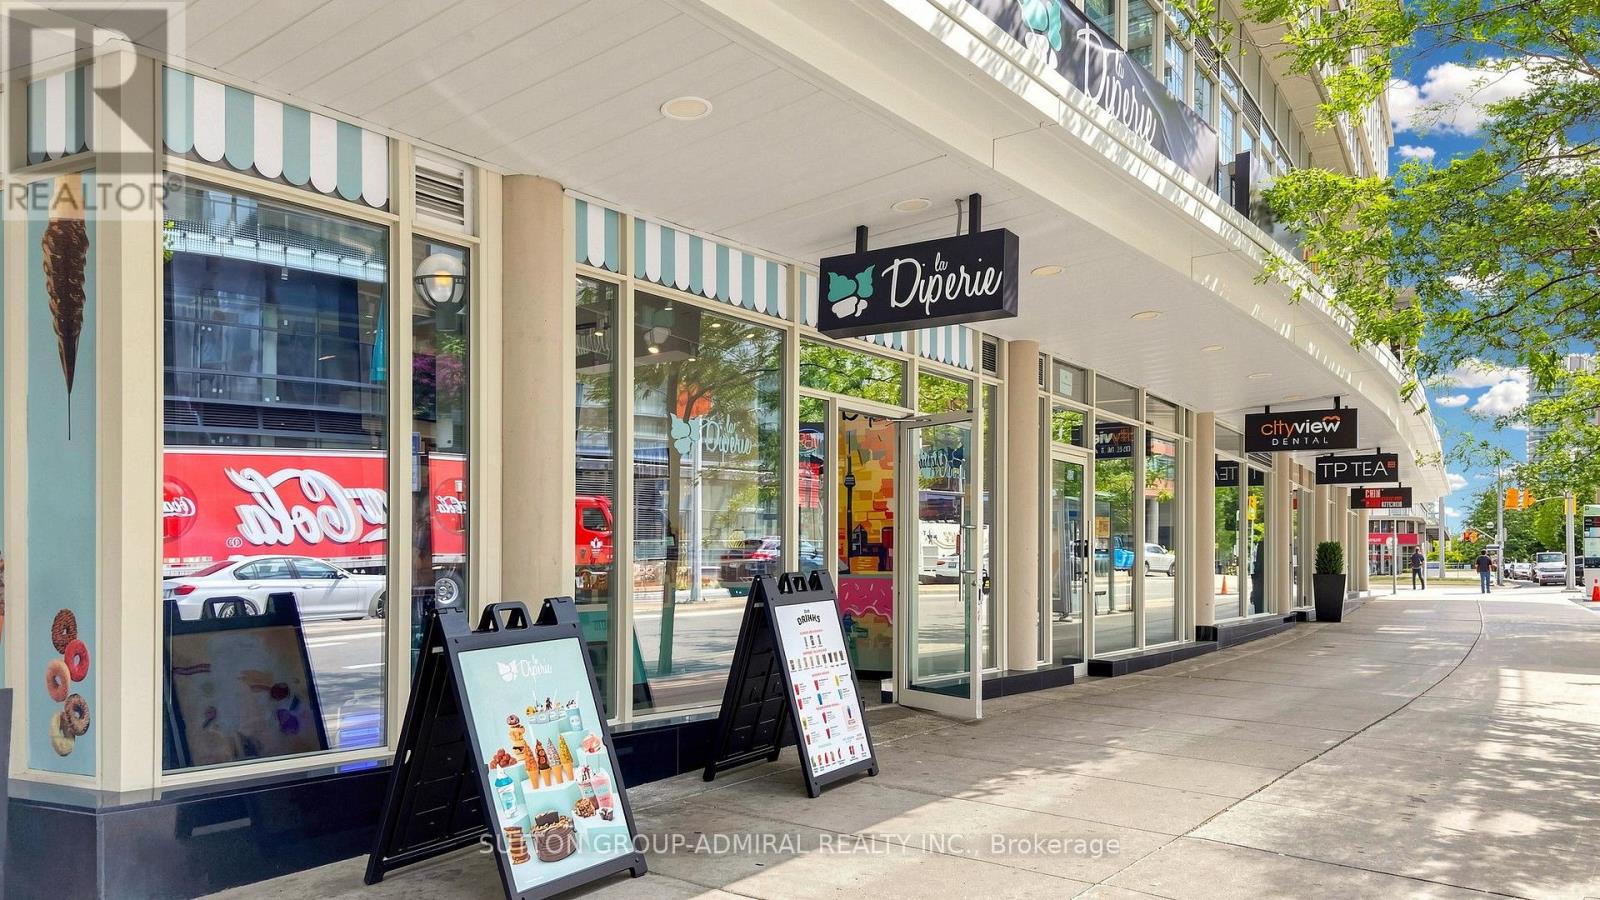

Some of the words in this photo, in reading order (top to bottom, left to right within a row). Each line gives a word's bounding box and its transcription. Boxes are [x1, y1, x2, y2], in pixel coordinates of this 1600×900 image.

[1077, 22, 1157, 146] Diperie
[934, 252, 949, 272] la
[881, 258, 1003, 315] Diperie
[1261, 417, 1340, 438] cityview
[1271, 436, 1329, 446] DENTAL
[1318, 462, 1348, 478] TP
[1350, 461, 1389, 477] TEA
